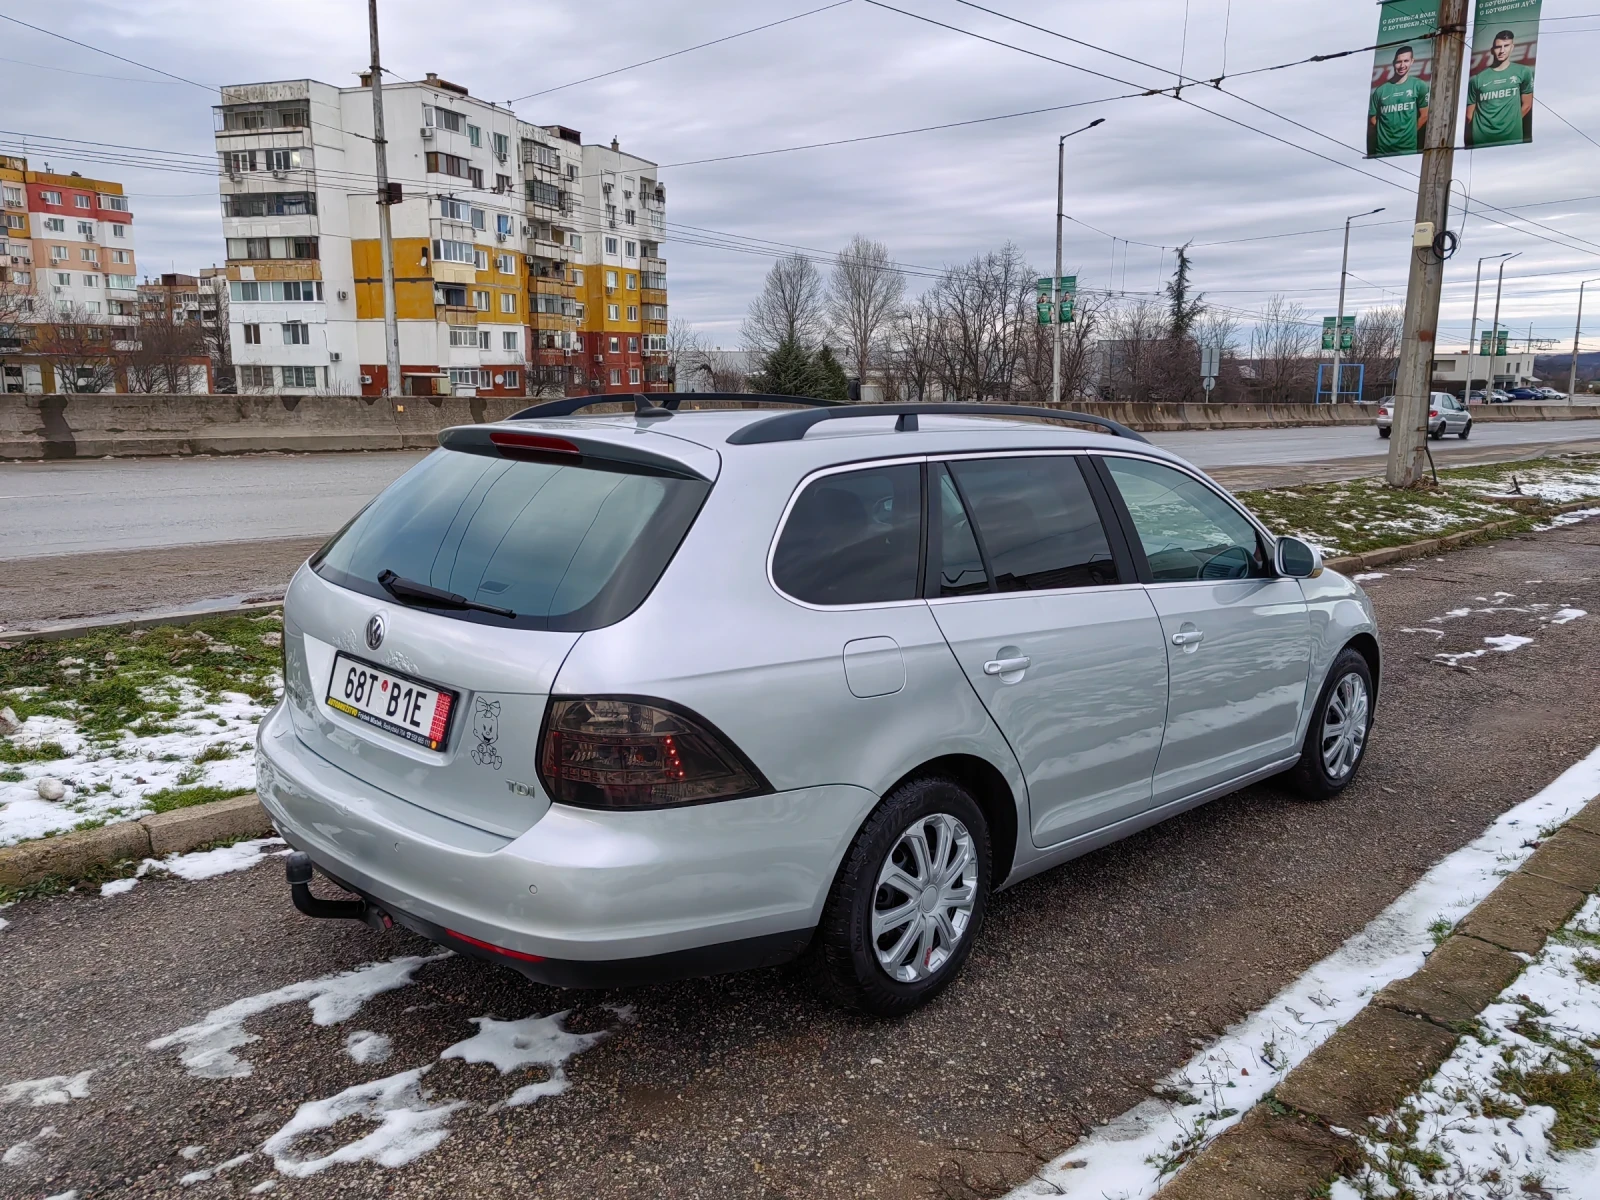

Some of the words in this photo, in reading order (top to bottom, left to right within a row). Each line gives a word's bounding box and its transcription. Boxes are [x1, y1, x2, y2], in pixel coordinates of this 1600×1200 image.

[1479, 87, 1519, 101] WINBET
[1380, 101, 1416, 114] WINBET
[344, 666, 379, 708] 68T
[385, 681, 428, 729] B1E
[505, 778, 535, 798] TDI
